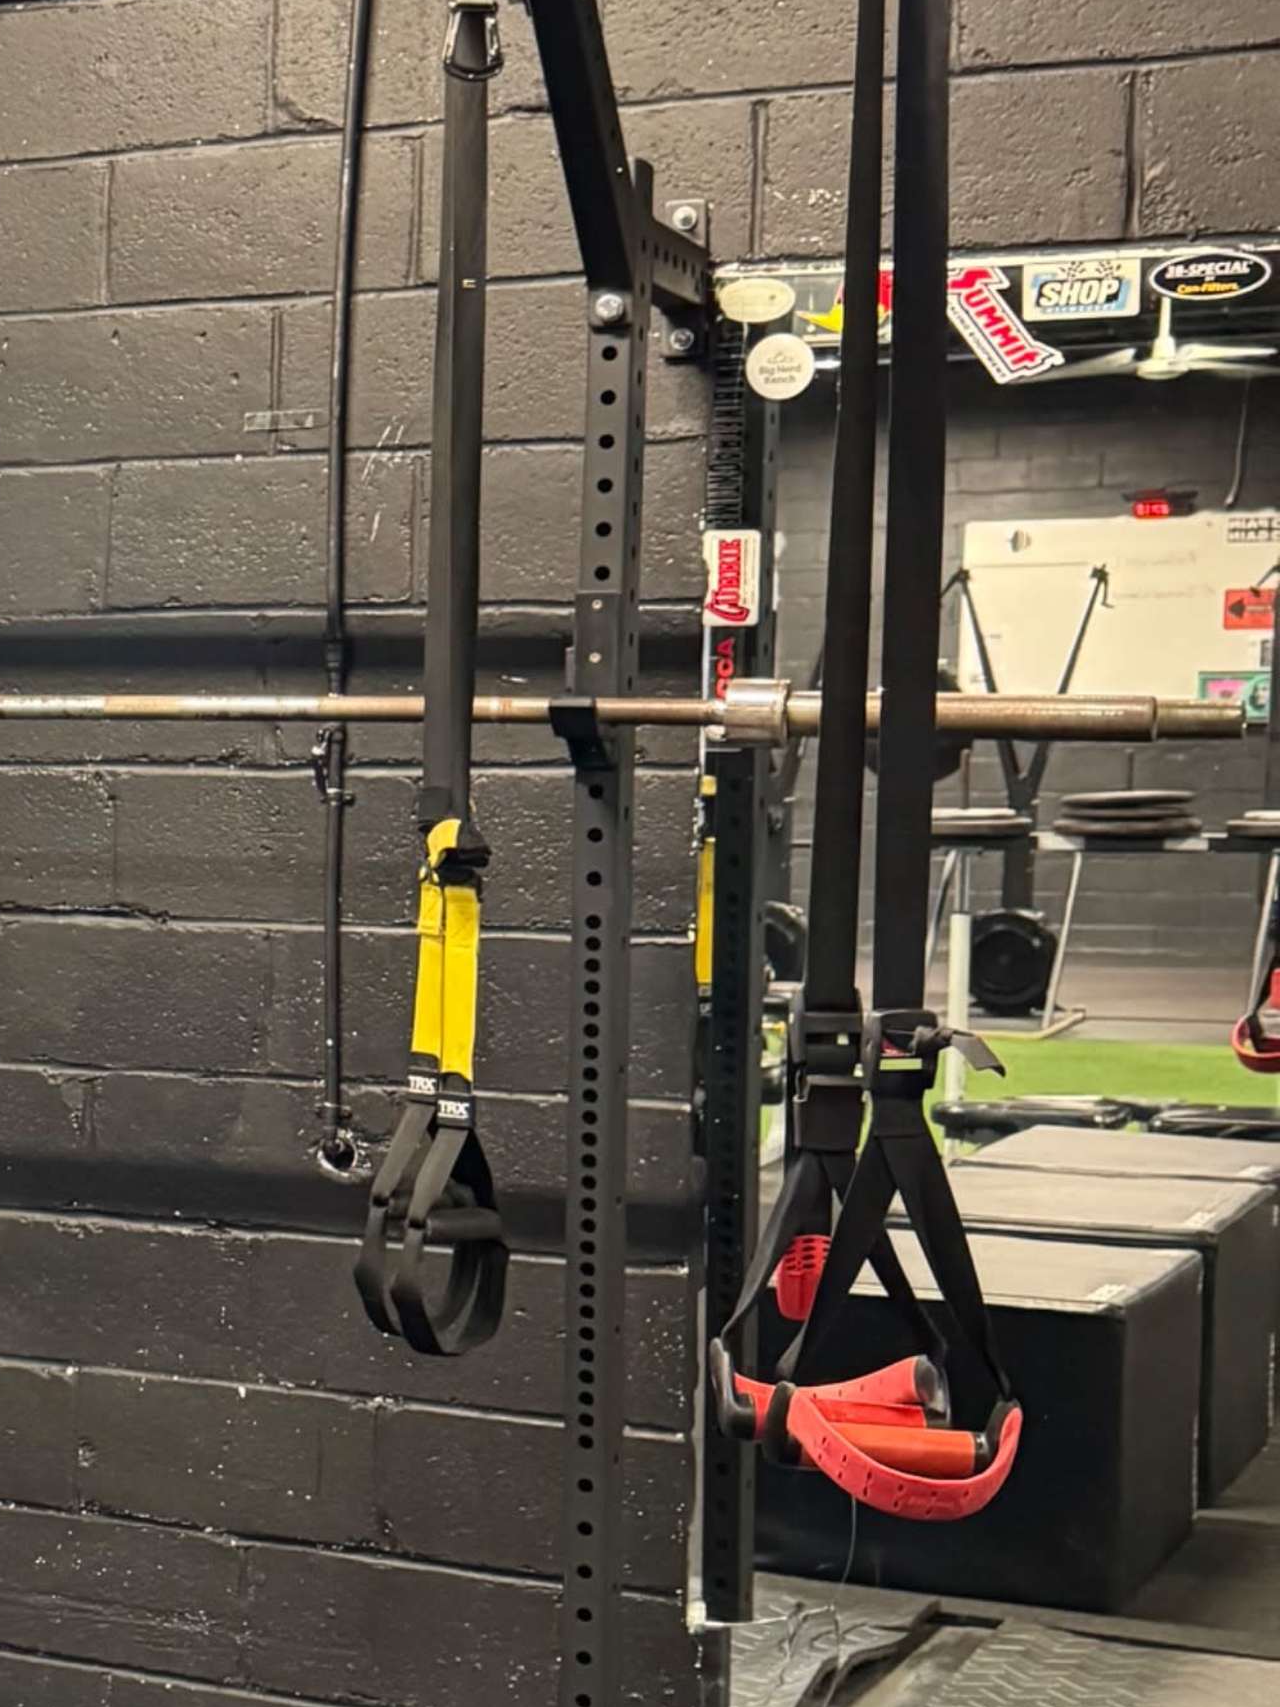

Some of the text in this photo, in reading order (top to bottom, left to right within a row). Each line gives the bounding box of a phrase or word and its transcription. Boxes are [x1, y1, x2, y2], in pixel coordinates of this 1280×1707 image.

[1039, 278, 1121, 308] SHOP
[408, 1075, 437, 1094] TRX
[438, 1099, 470, 1119] TRX
